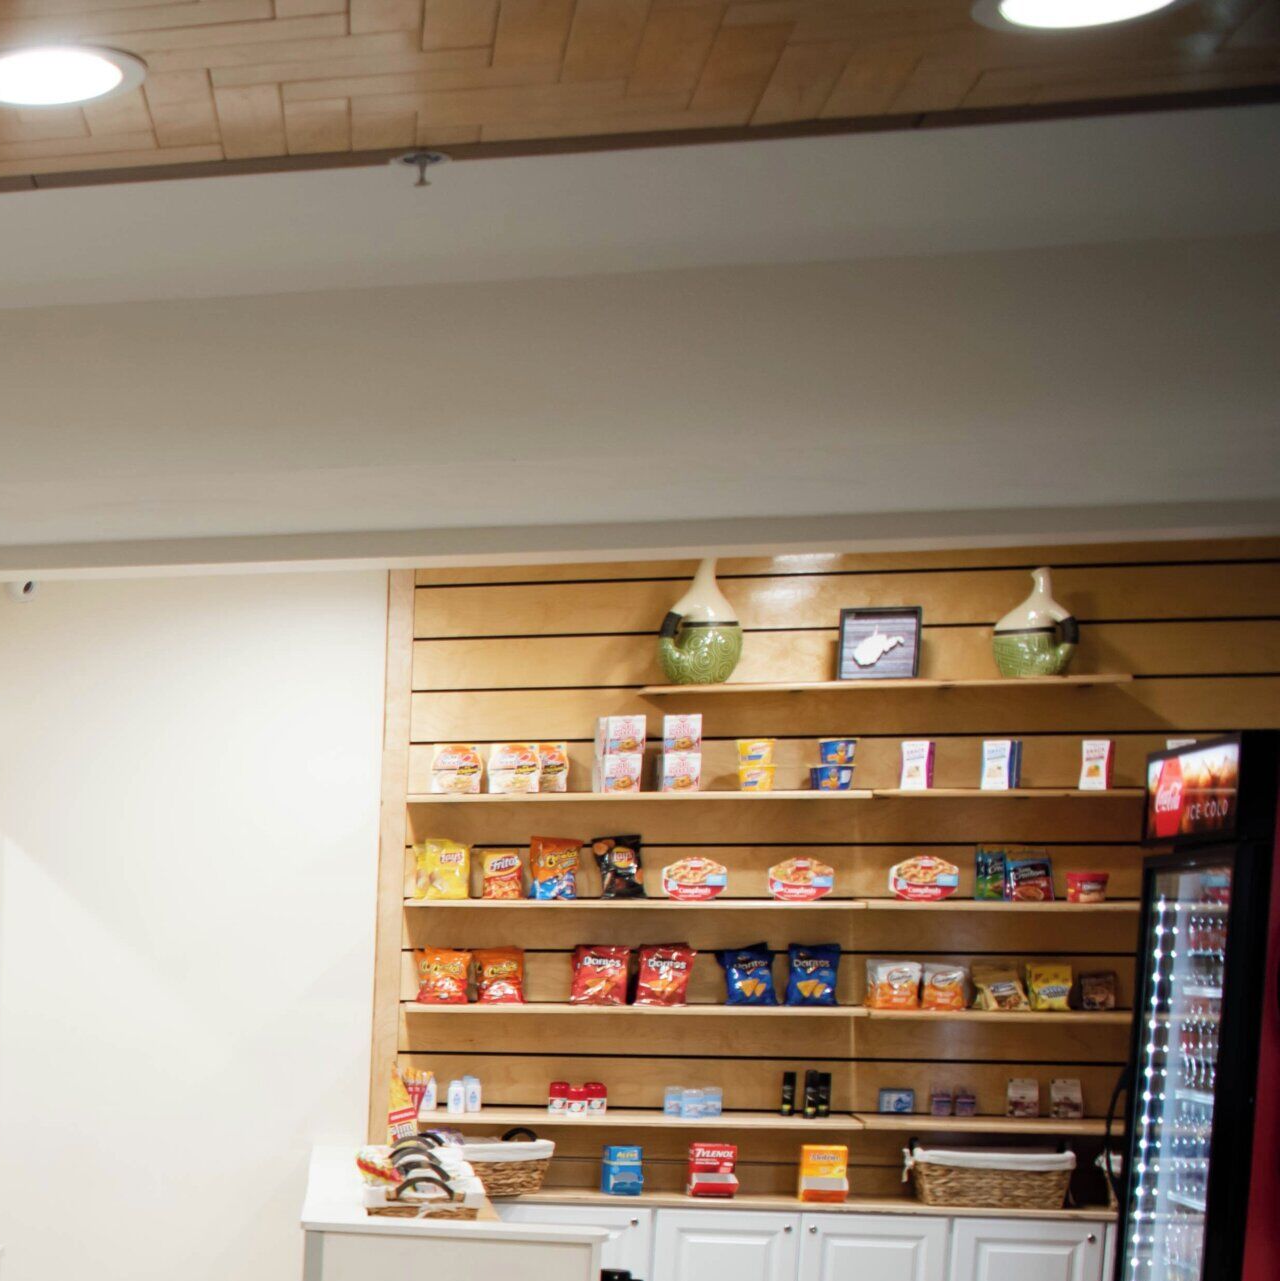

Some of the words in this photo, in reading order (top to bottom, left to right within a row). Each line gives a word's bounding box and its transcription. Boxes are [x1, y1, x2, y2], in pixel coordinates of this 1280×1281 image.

[1186, 803, 1201, 820] ICE
[1203, 799, 1229, 819] COLD
[583, 956, 622, 968] Doritos
[695, 1147, 734, 1159] TYLENOL
